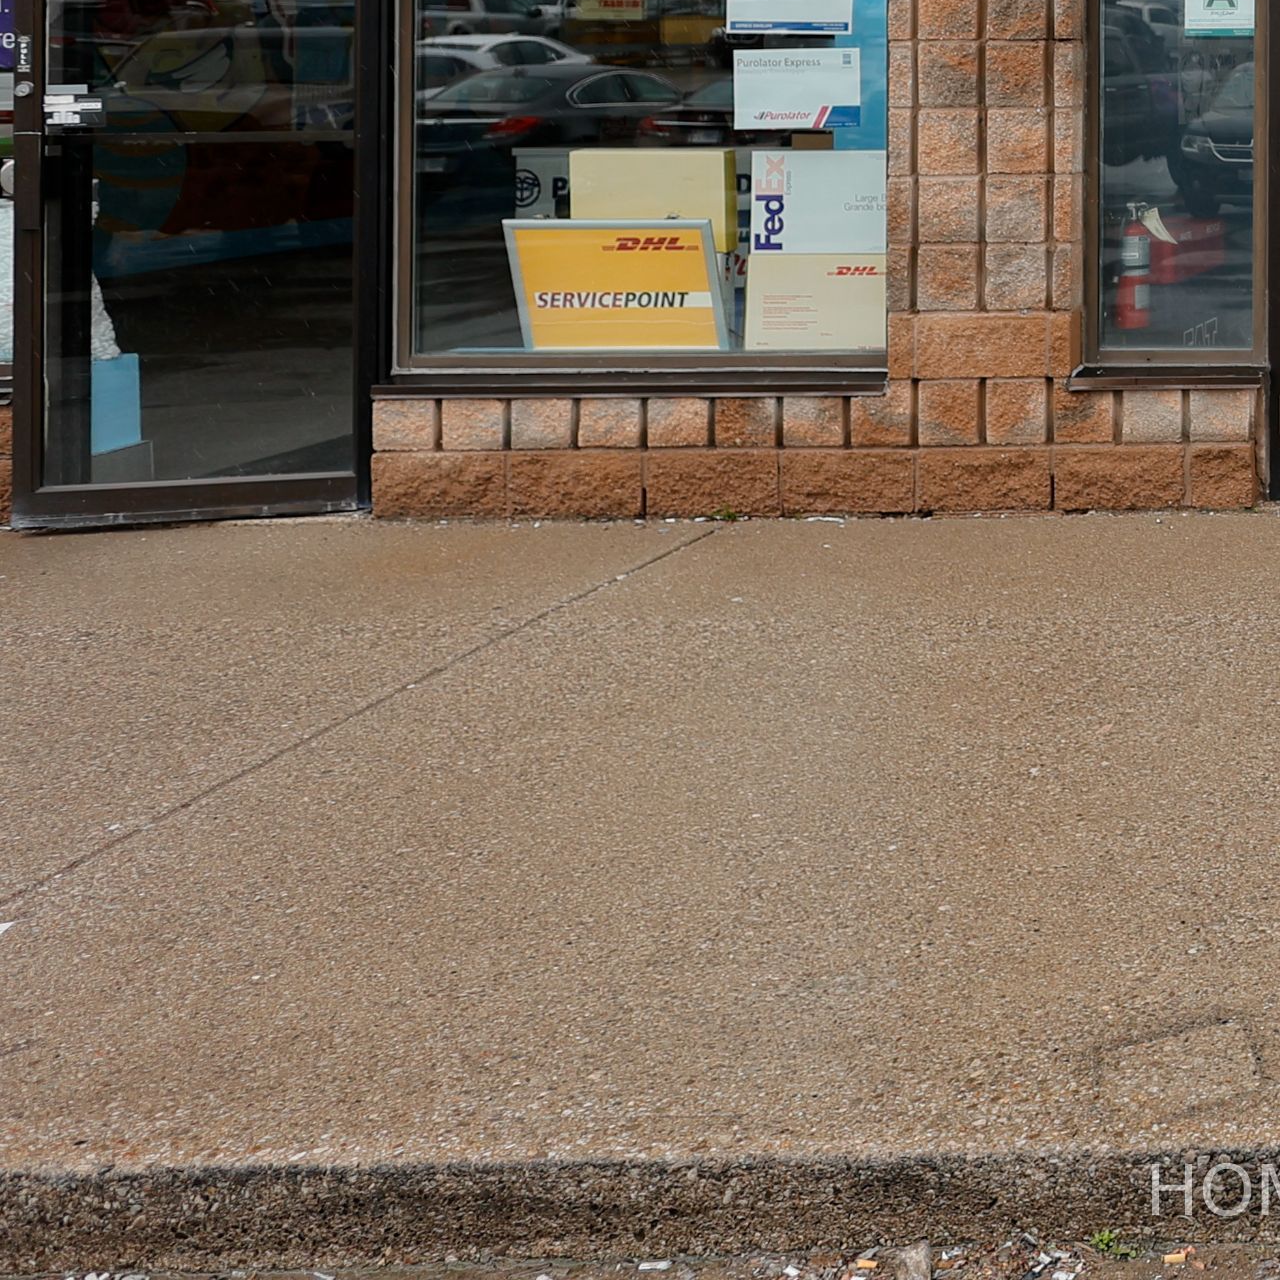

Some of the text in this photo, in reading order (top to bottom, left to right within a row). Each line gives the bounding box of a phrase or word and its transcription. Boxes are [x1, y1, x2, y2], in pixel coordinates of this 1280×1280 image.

[737, 58, 821, 70] Purolator Express
[764, 111, 812, 121] Purolator
[755, 155, 784, 250] FedEx
[855, 195, 878, 204] Large
[844, 203, 874, 211] Grande
[615, 237, 686, 251] DHL
[835, 266, 879, 276] DHL
[536, 291, 689, 309] SERVICEPOINT
